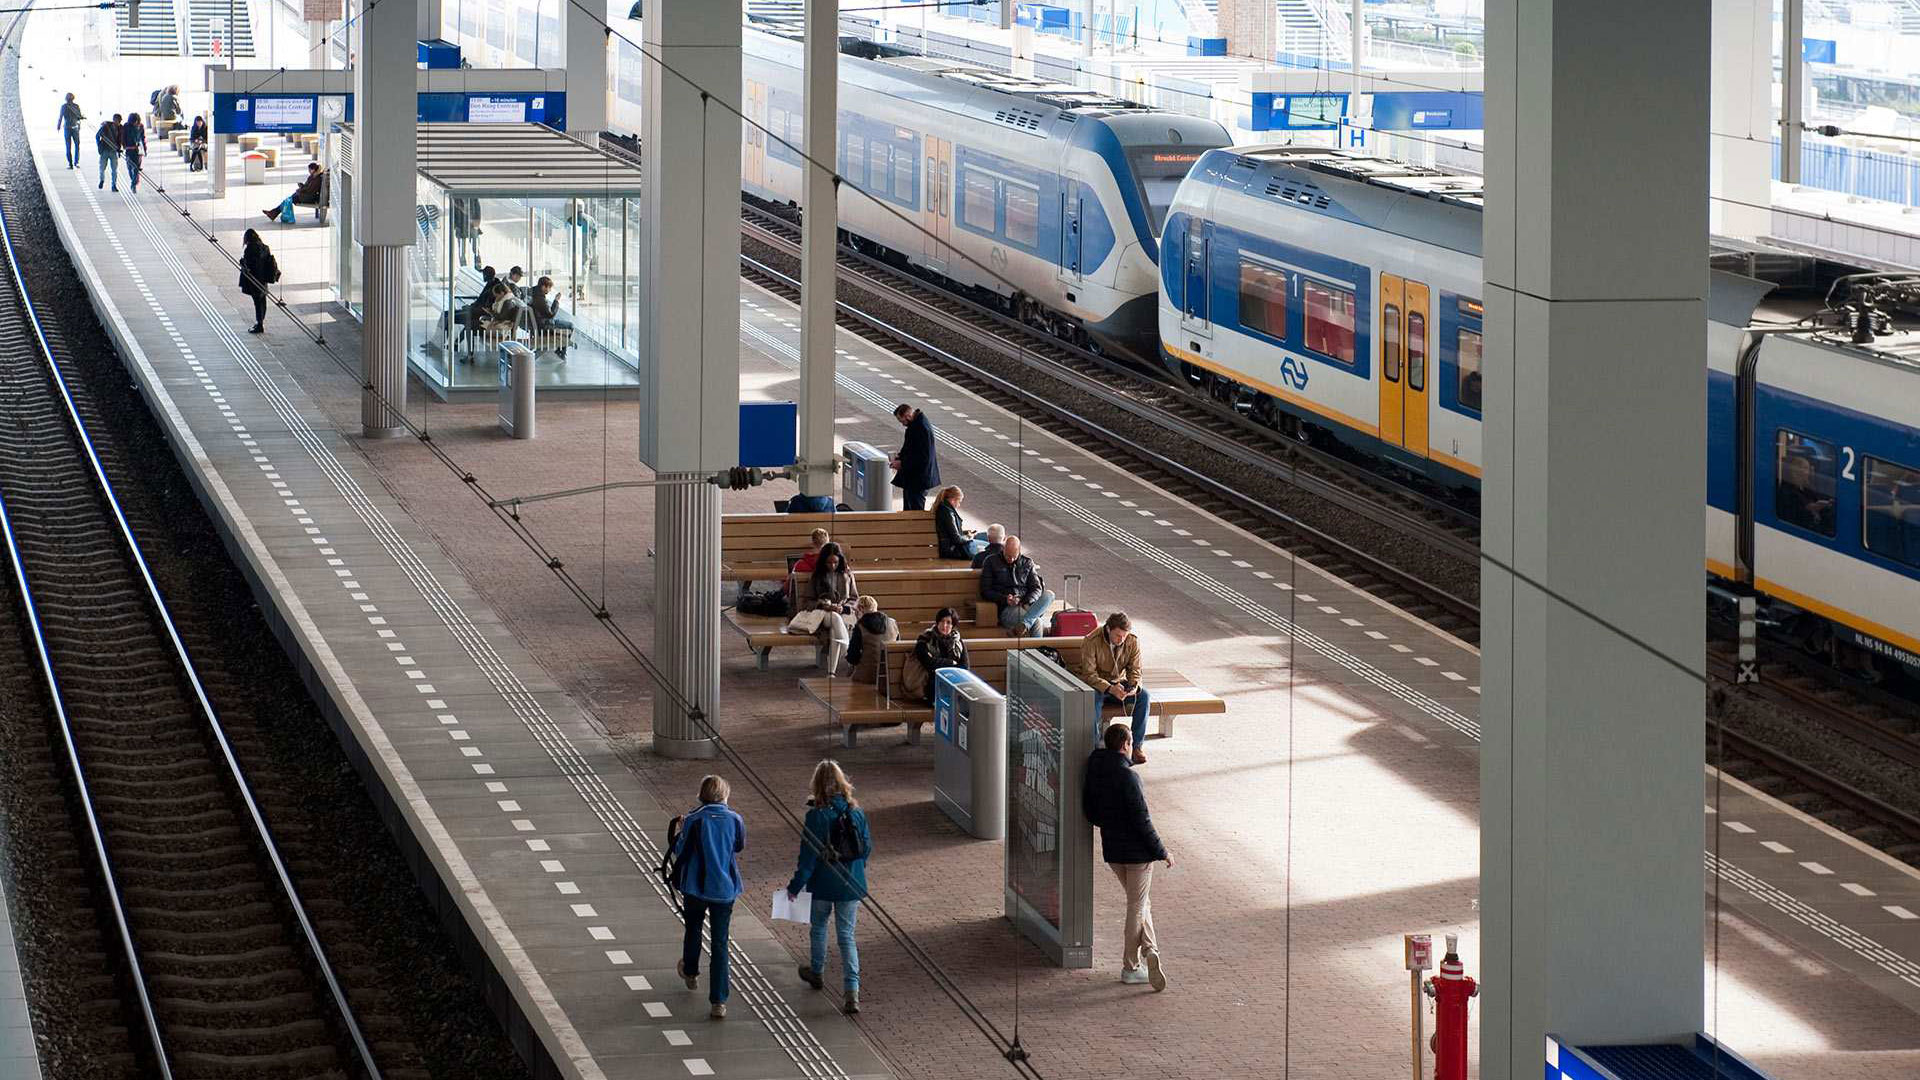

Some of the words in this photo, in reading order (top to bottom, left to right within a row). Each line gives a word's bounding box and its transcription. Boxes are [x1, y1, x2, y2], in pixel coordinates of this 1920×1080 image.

[1350, 129, 1365, 147] H
[888, 144, 894, 162] 2
[1292, 273, 1298, 298] 1
[1842, 446, 1856, 481] 2
